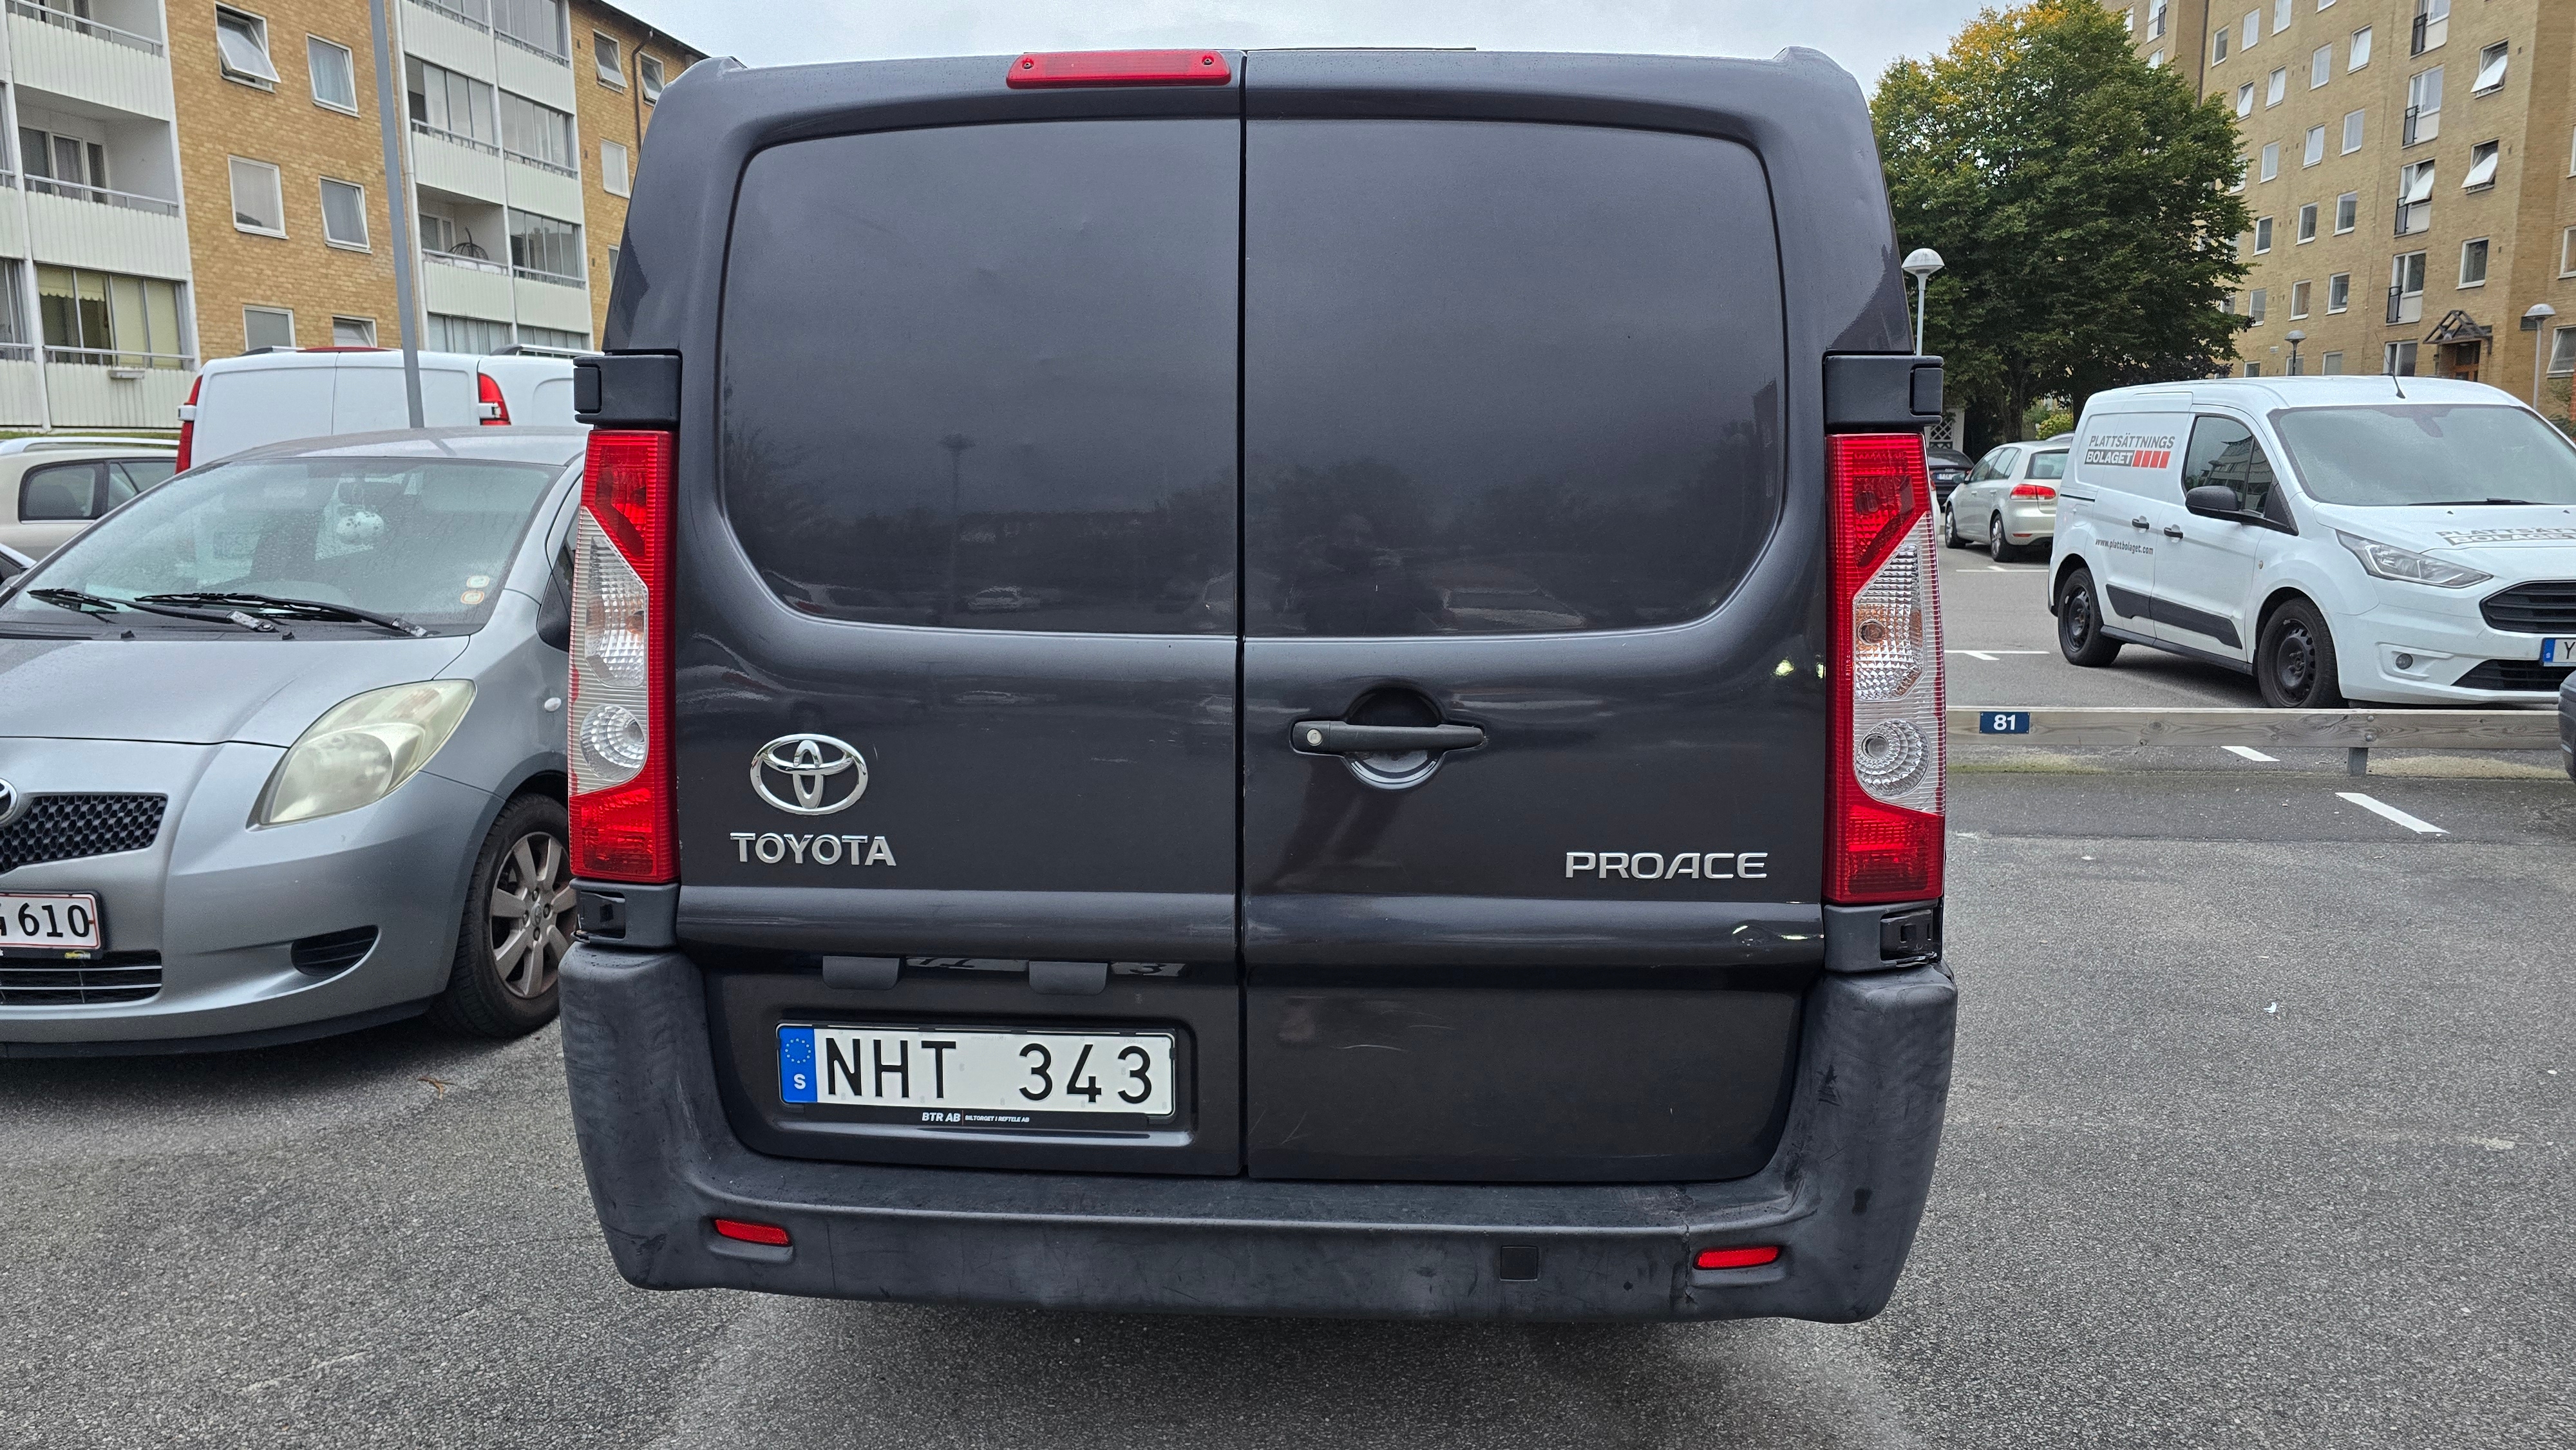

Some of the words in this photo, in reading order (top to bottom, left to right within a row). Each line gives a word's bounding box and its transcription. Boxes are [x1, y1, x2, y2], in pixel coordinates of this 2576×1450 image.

[2088, 432, 2175, 449] PLATTSÄTTNINGS
[2086, 451, 2134, 464] BOLAGET
[2095, 538, 2154, 554] www.plattbolaget.com
[1993, 714, 2016, 731] 81
[730, 833, 896, 866] TOYOTA
[1566, 852, 1768, 880] PROACE
[826, 1037, 957, 1098] NHT
[1019, 1043, 1152, 1104] 343
[793, 1073, 806, 1089] S
[922, 1112, 944, 1122] BTR
[945, 1113, 961, 1122] AB
